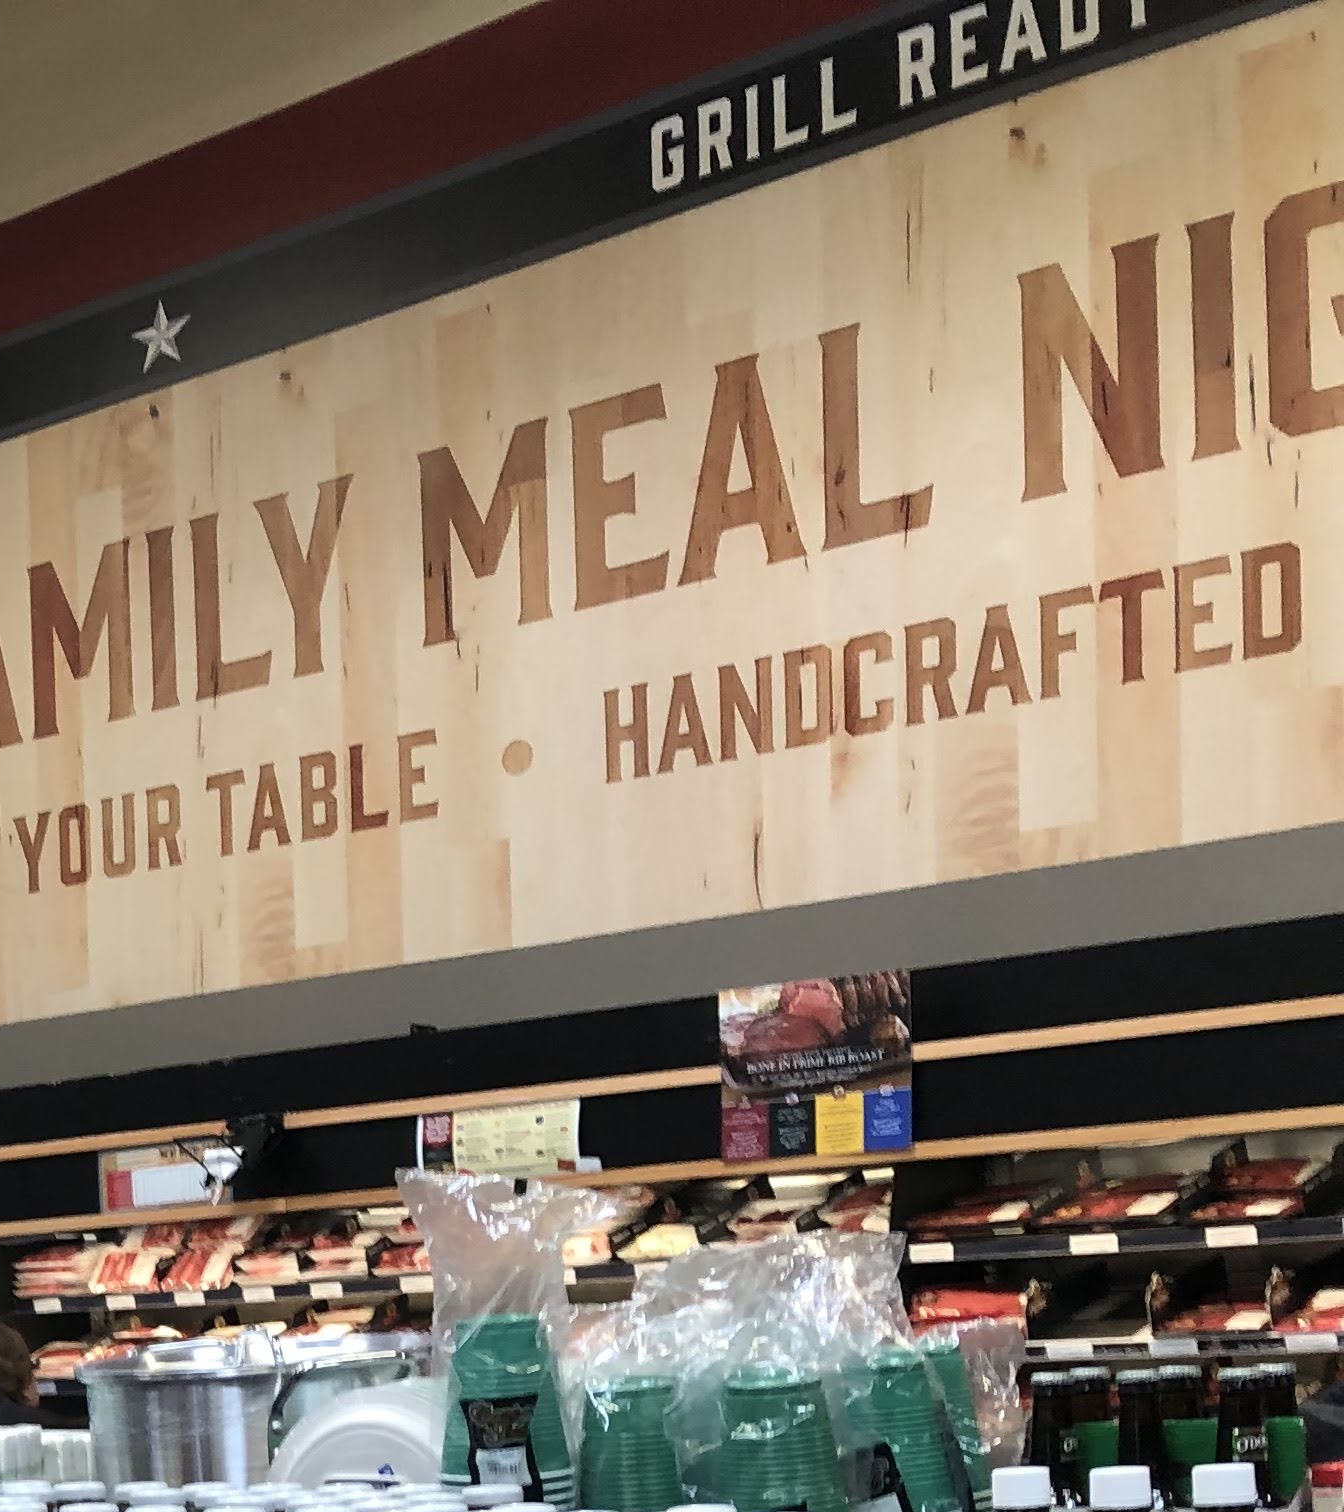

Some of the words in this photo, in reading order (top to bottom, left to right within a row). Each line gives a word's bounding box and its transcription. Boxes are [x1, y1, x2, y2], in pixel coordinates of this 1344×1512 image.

[650, 56, 858, 194] GRILL
[418, 323, 934, 647] MEAL
[602, 541, 1303, 784] HANDCRAFTED
[12, 782, 183, 895] YOUR
[206, 728, 439, 856] TABLE
